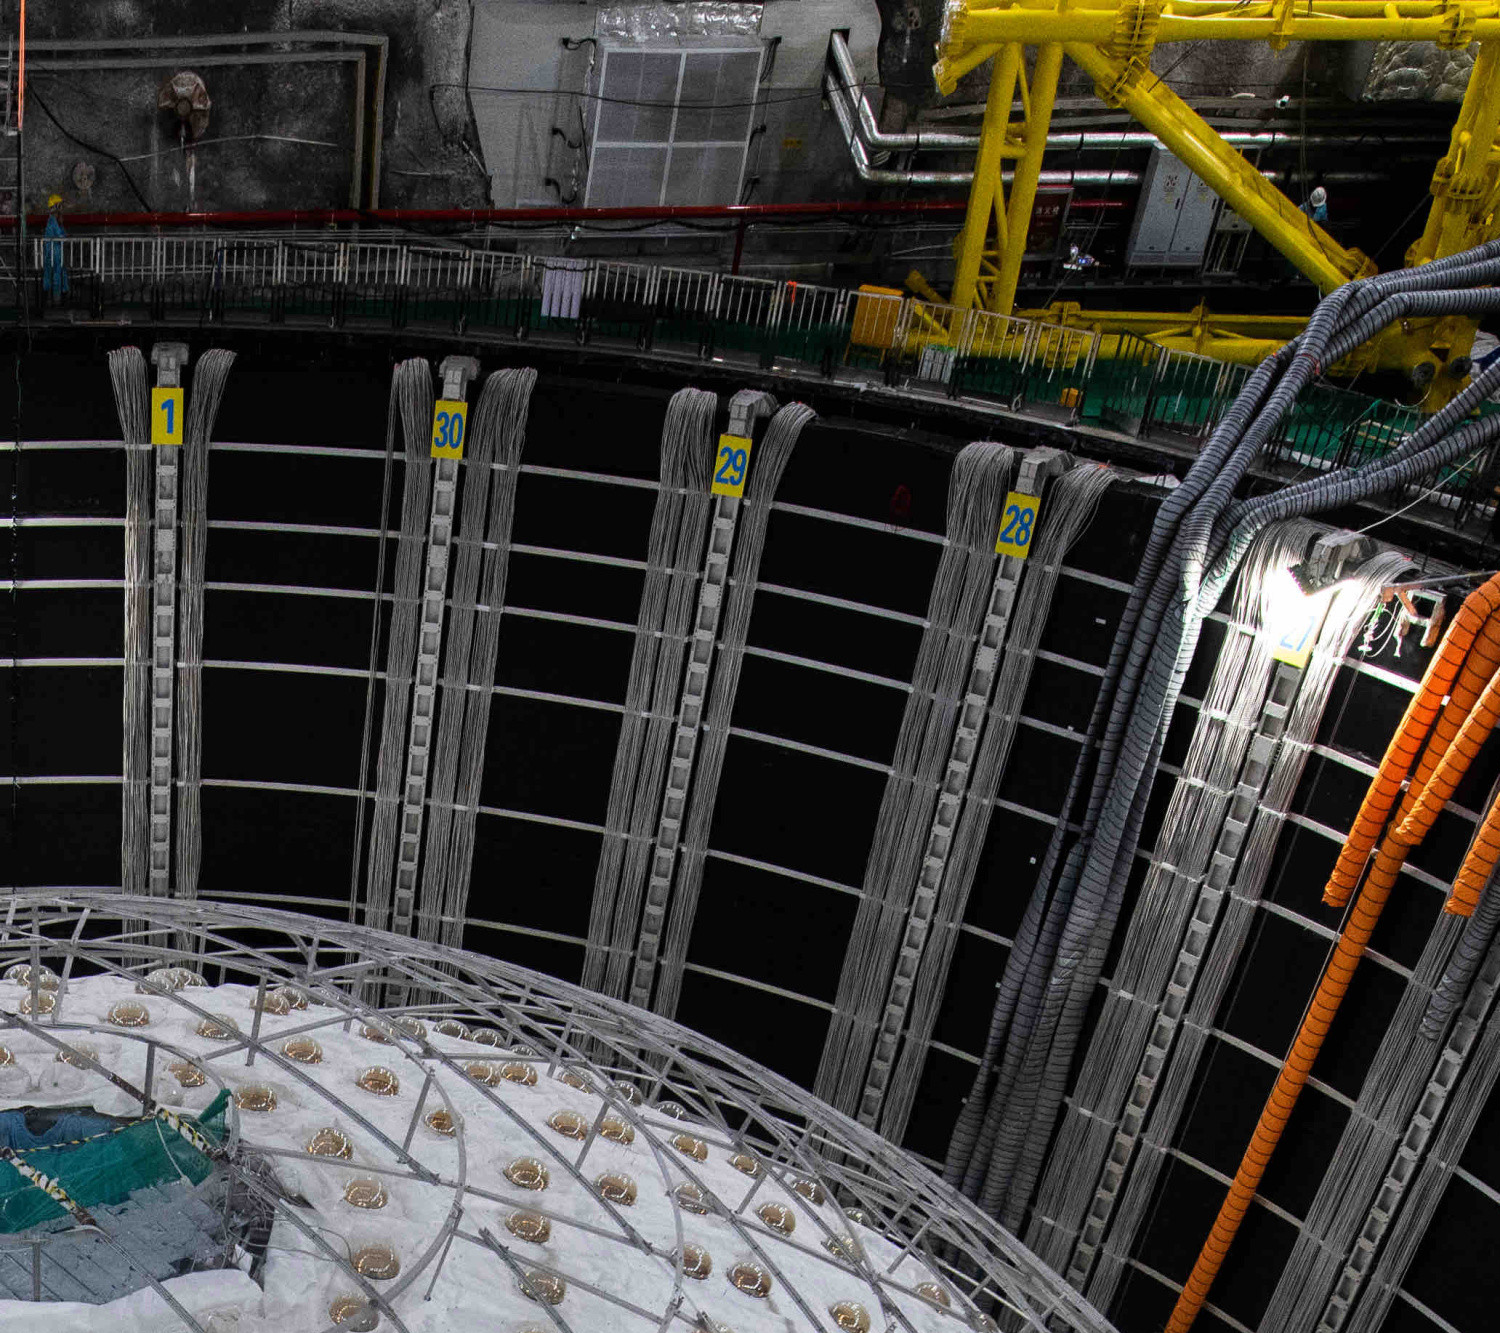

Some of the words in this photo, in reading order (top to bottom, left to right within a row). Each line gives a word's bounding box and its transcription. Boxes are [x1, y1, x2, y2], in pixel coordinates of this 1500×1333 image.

[161, 398, 174, 434] 1
[434, 411, 464, 449] 30
[714, 446, 747, 486] 29
[999, 504, 1035, 547] 28
